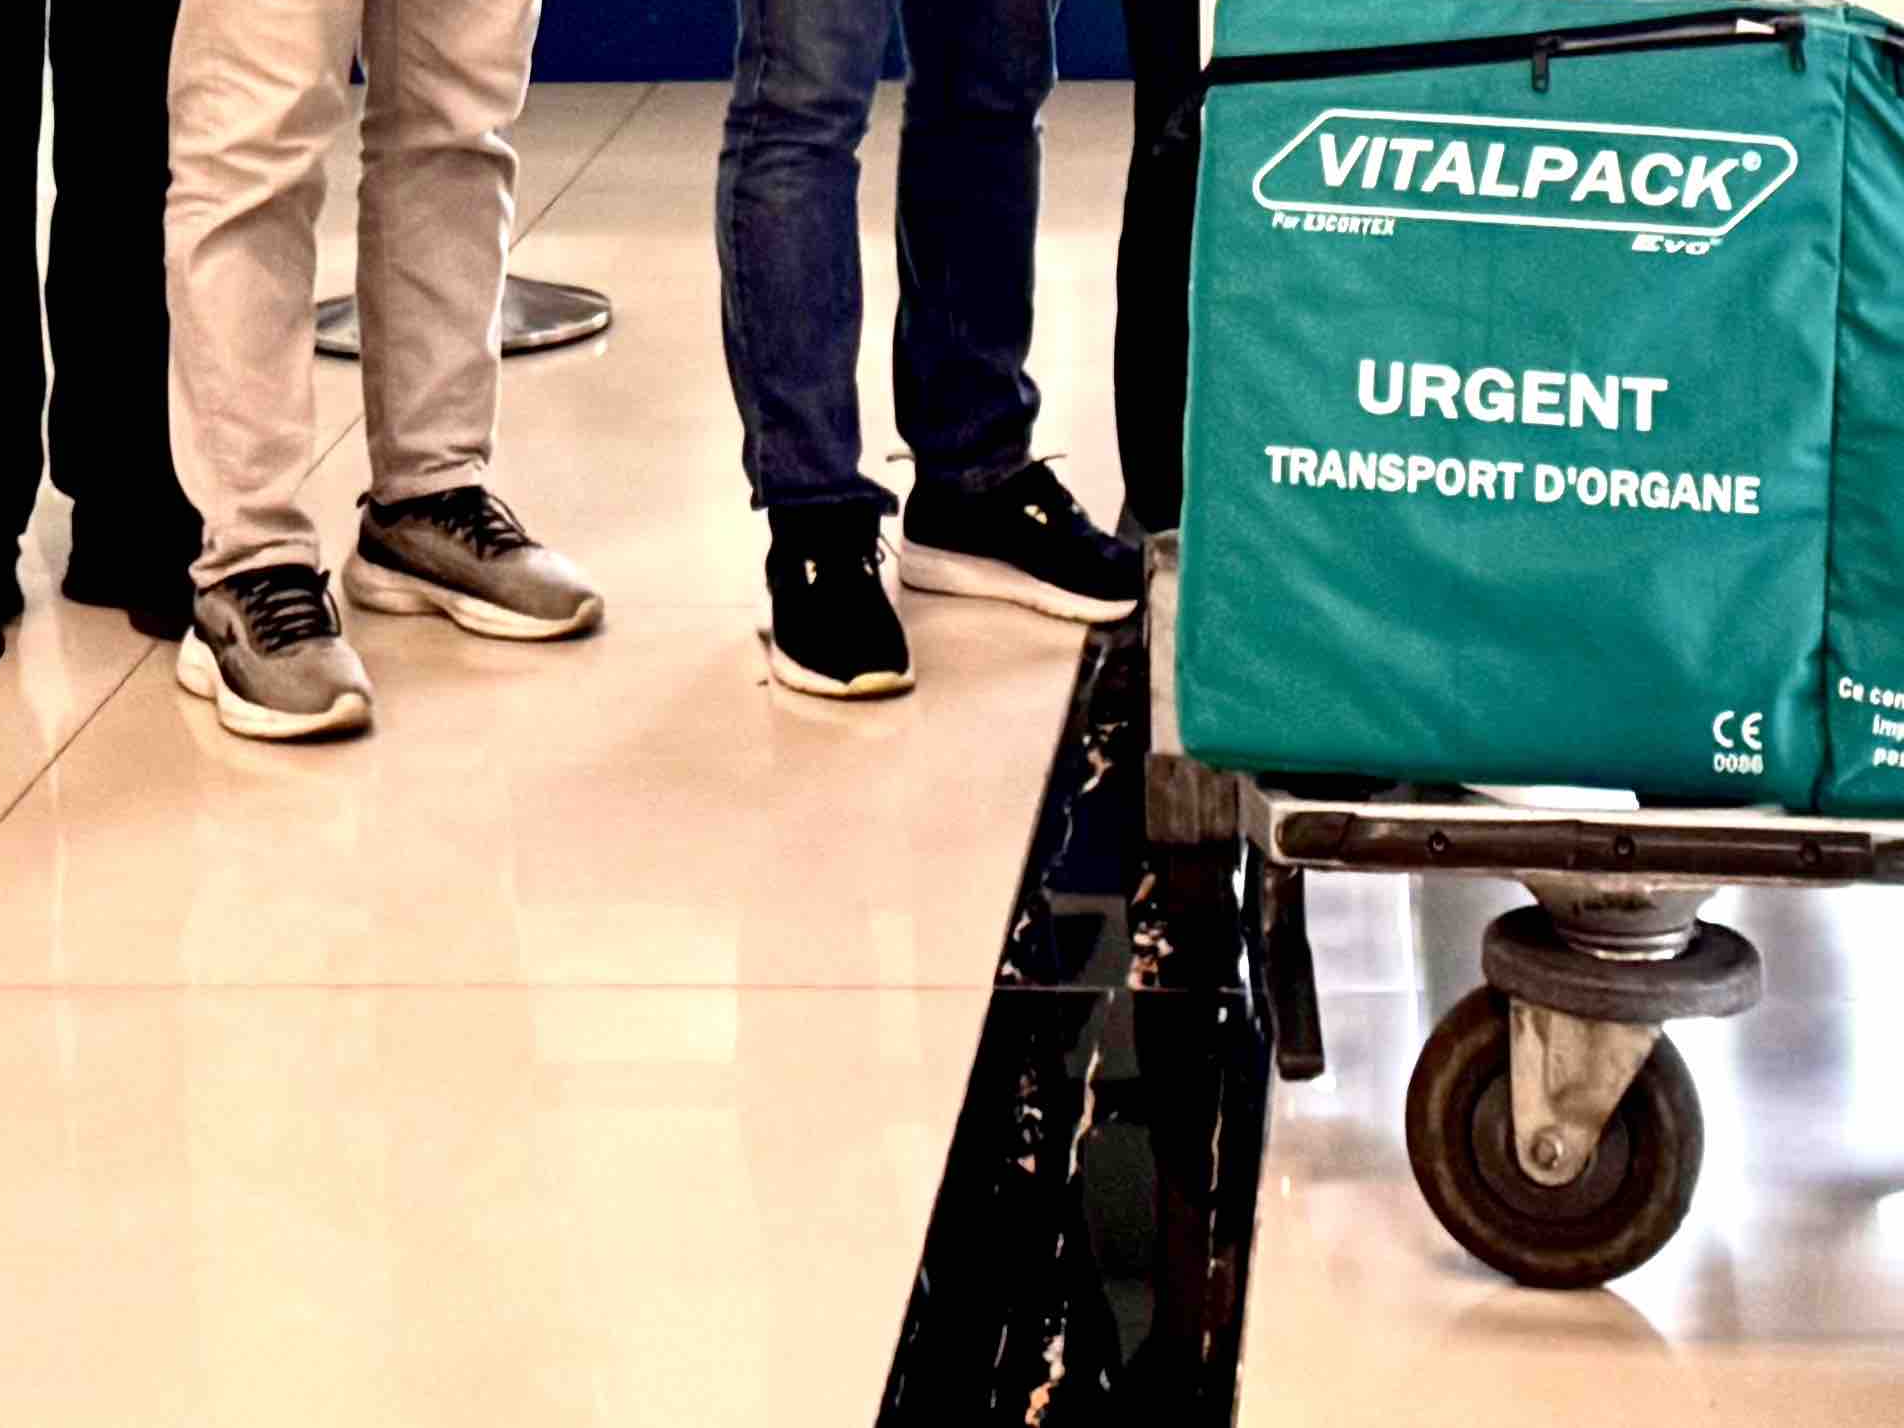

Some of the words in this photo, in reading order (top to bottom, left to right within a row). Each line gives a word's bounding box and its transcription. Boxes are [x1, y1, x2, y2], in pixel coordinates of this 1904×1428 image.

[1357, 358, 1669, 433] URGENT
[1264, 444, 1525, 501] TRANSPORT
[1534, 462, 1761, 516] D'ORGANE
[1838, 676, 1864, 702] Ce
[1712, 710, 1764, 751] CE
